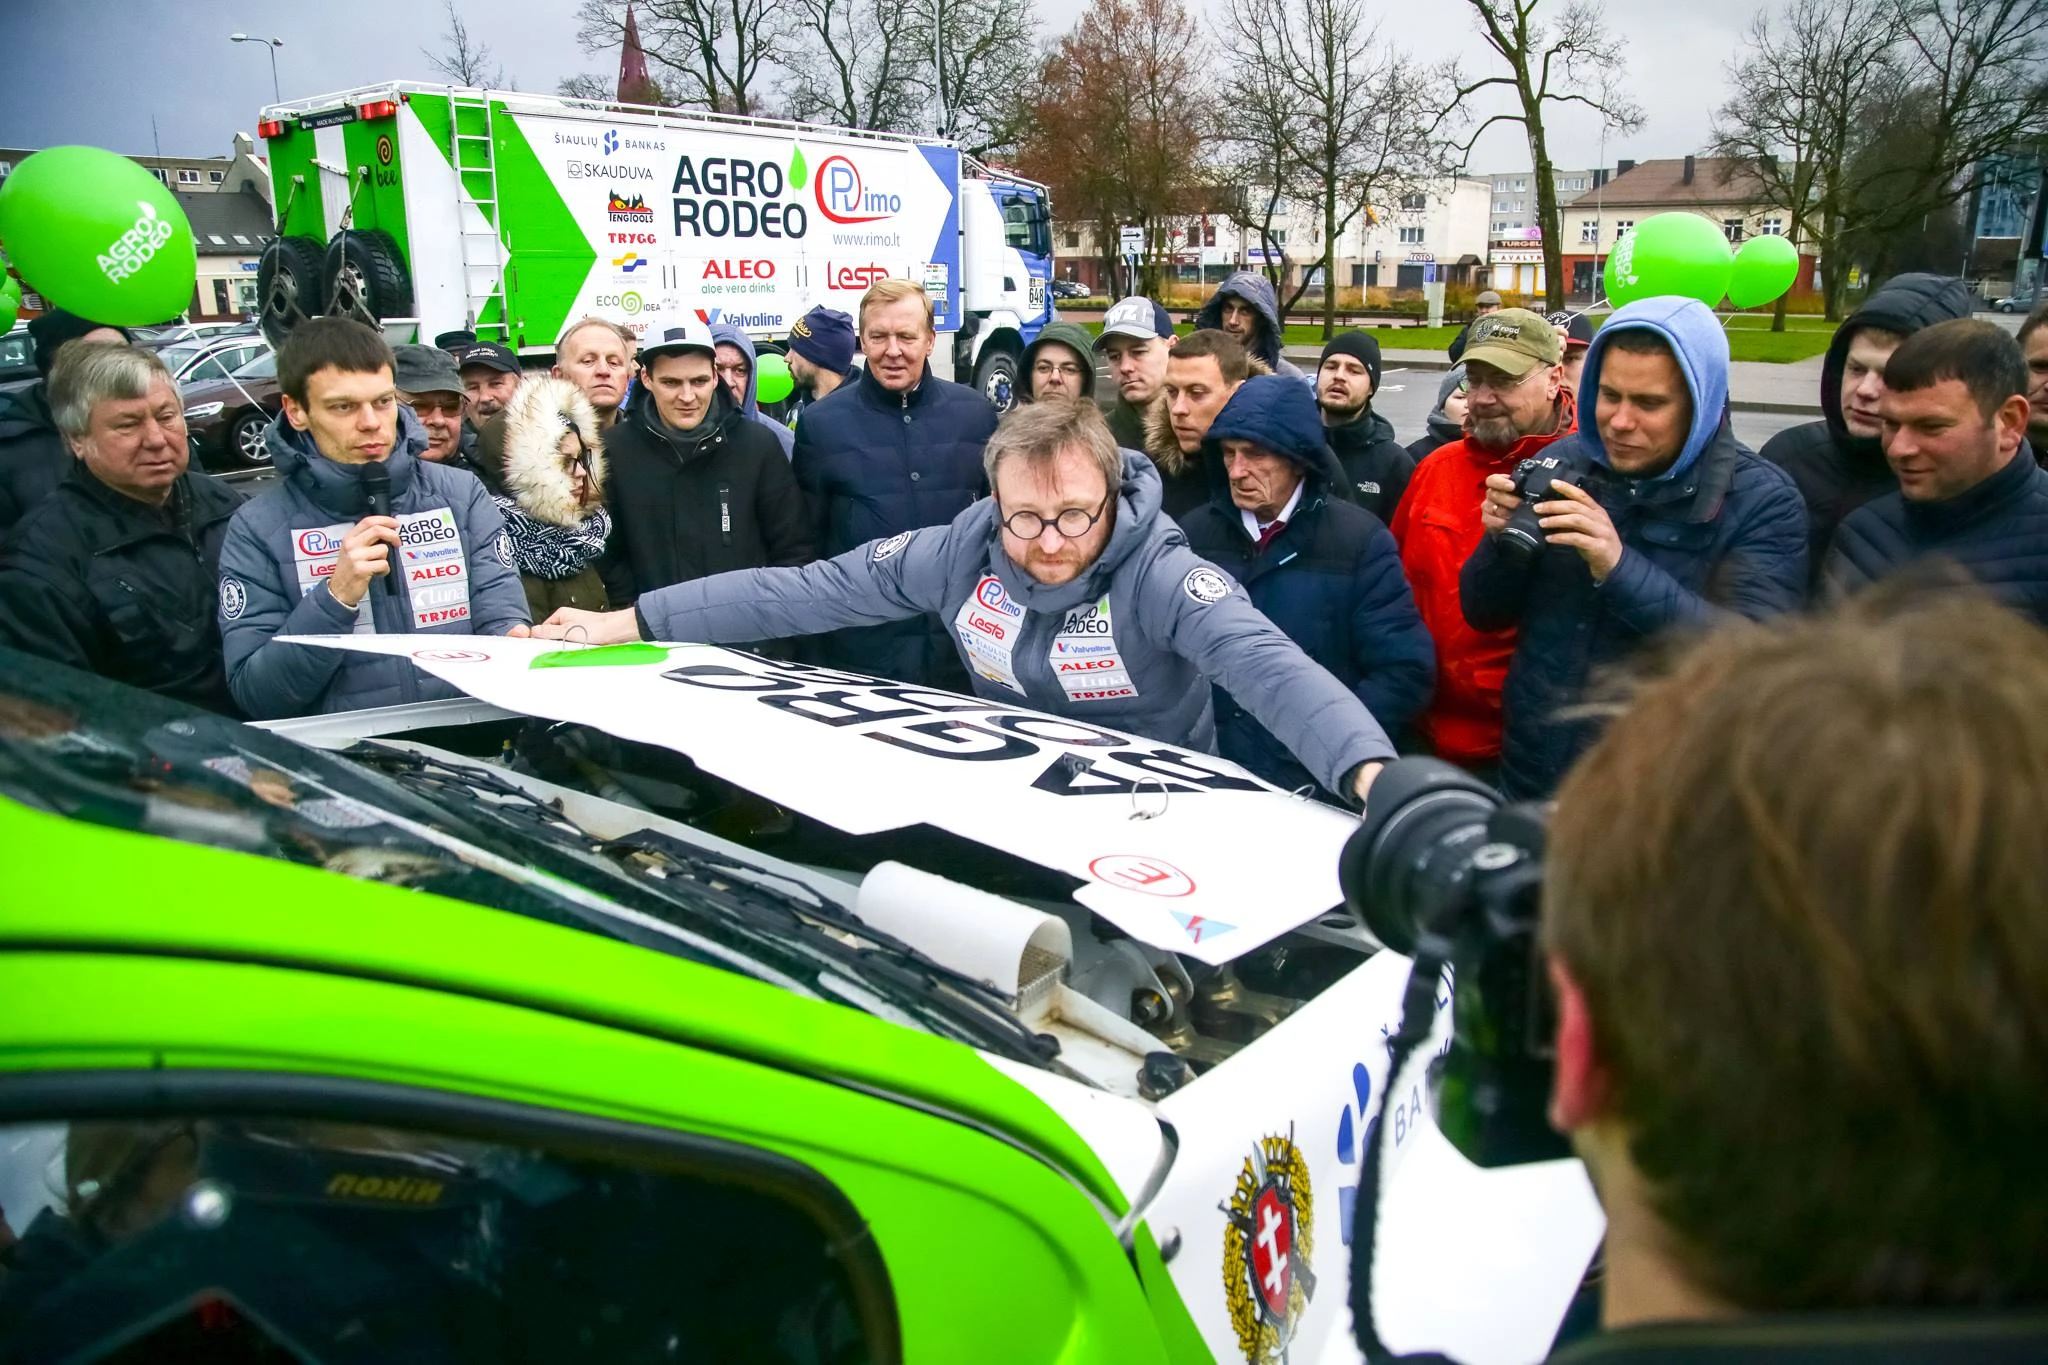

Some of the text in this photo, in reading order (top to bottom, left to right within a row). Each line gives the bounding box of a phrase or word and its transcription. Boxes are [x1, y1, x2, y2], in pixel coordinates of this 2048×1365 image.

[554, 131, 666, 151] ŠIAULIŲ BANKAS
[376, 163, 397, 188] bee
[584, 163, 653, 181] SKAUDUVA
[671, 155, 783, 199] AGRO
[672, 198, 808, 239] RODEO
[96, 217, 153, 273] AGRO
[608, 233, 657, 244] TRYGG
[832, 233, 901, 248] www.rimo.lt
[106, 220, 173, 285] RODEO
[701, 259, 776, 280] ALEO
[701, 283, 723, 294] aloe
[749, 282, 776, 293] drinks
[1029, 287, 1044, 304] 648
[596, 295, 620, 307] ECO
[643, 303, 661, 312] IDEA
[723, 312, 783, 327] Valvoline
[398, 518, 442, 536] AGRO
[307, 533, 343, 551] Rim
[398, 527, 456, 546] RODEO
[423, 547, 459, 559] Valvoline
[310, 564, 337, 577] Les
[412, 564, 461, 581] ALEO
[430, 586, 465, 603] Luna
[419, 606, 468, 623] TRYGG
[968, 611, 1005, 641] Lesta
[1071, 645, 1112, 654] Valvoline
[1060, 659, 1115, 672] ALEO
[1071, 688, 1132, 699] TRYGG
